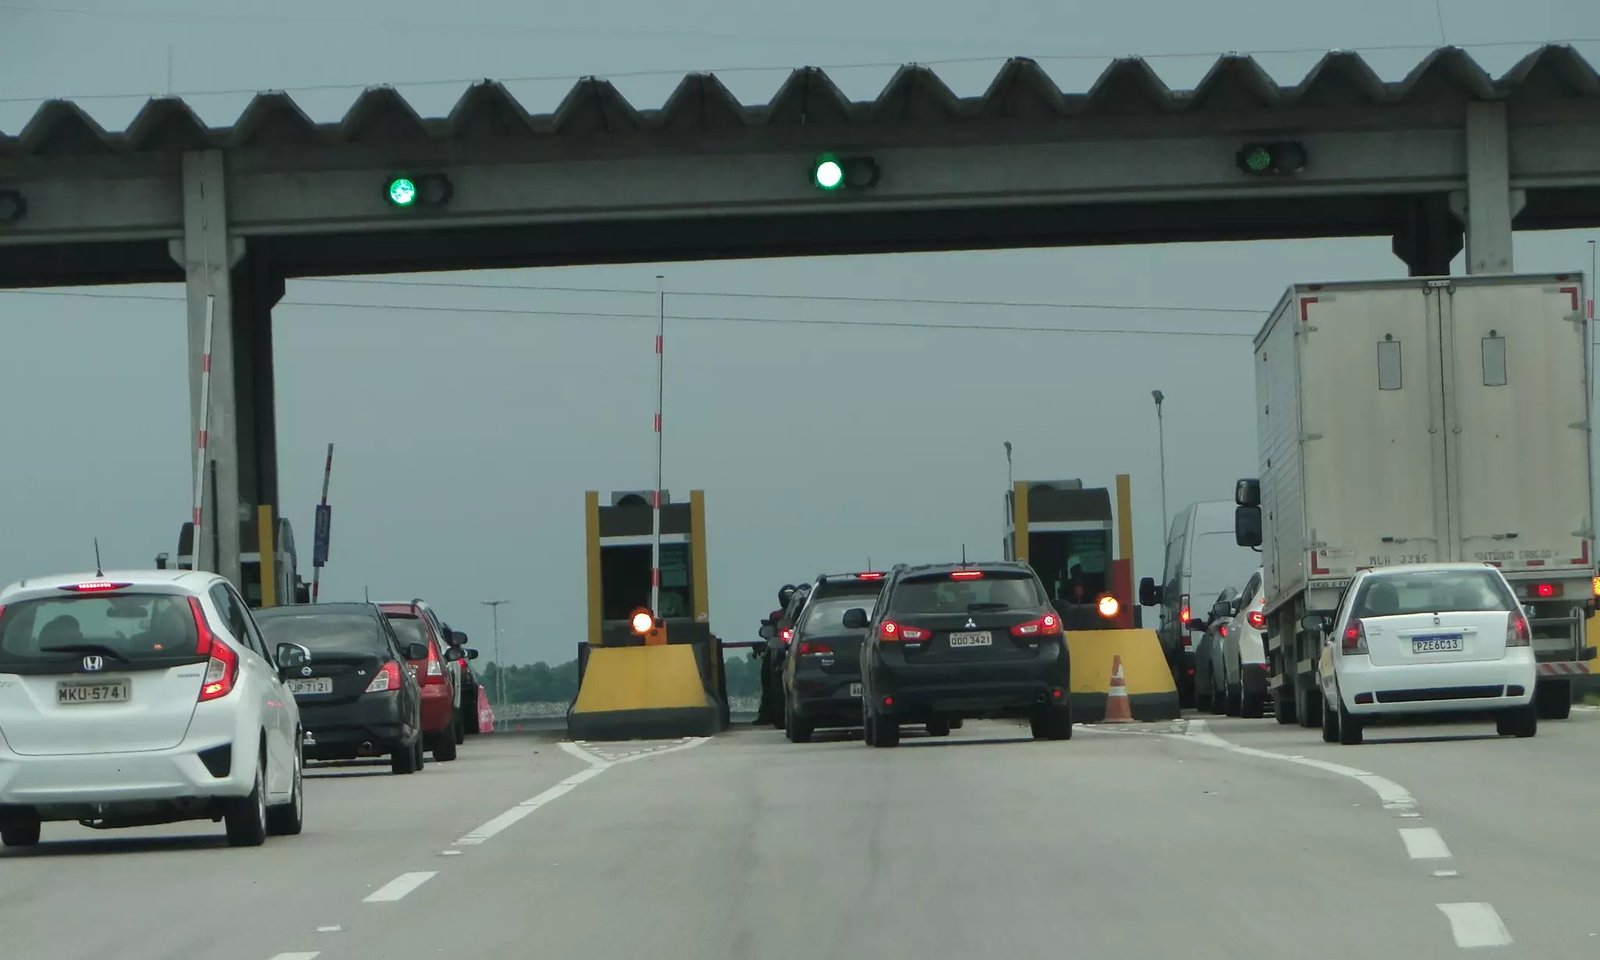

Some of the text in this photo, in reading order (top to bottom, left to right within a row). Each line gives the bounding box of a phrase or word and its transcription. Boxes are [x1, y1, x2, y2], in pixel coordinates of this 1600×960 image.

[1416, 639, 1458, 651] PZE6C13
[306, 682, 328, 692] 7121
[58, 686, 127, 701] MKU-5741
